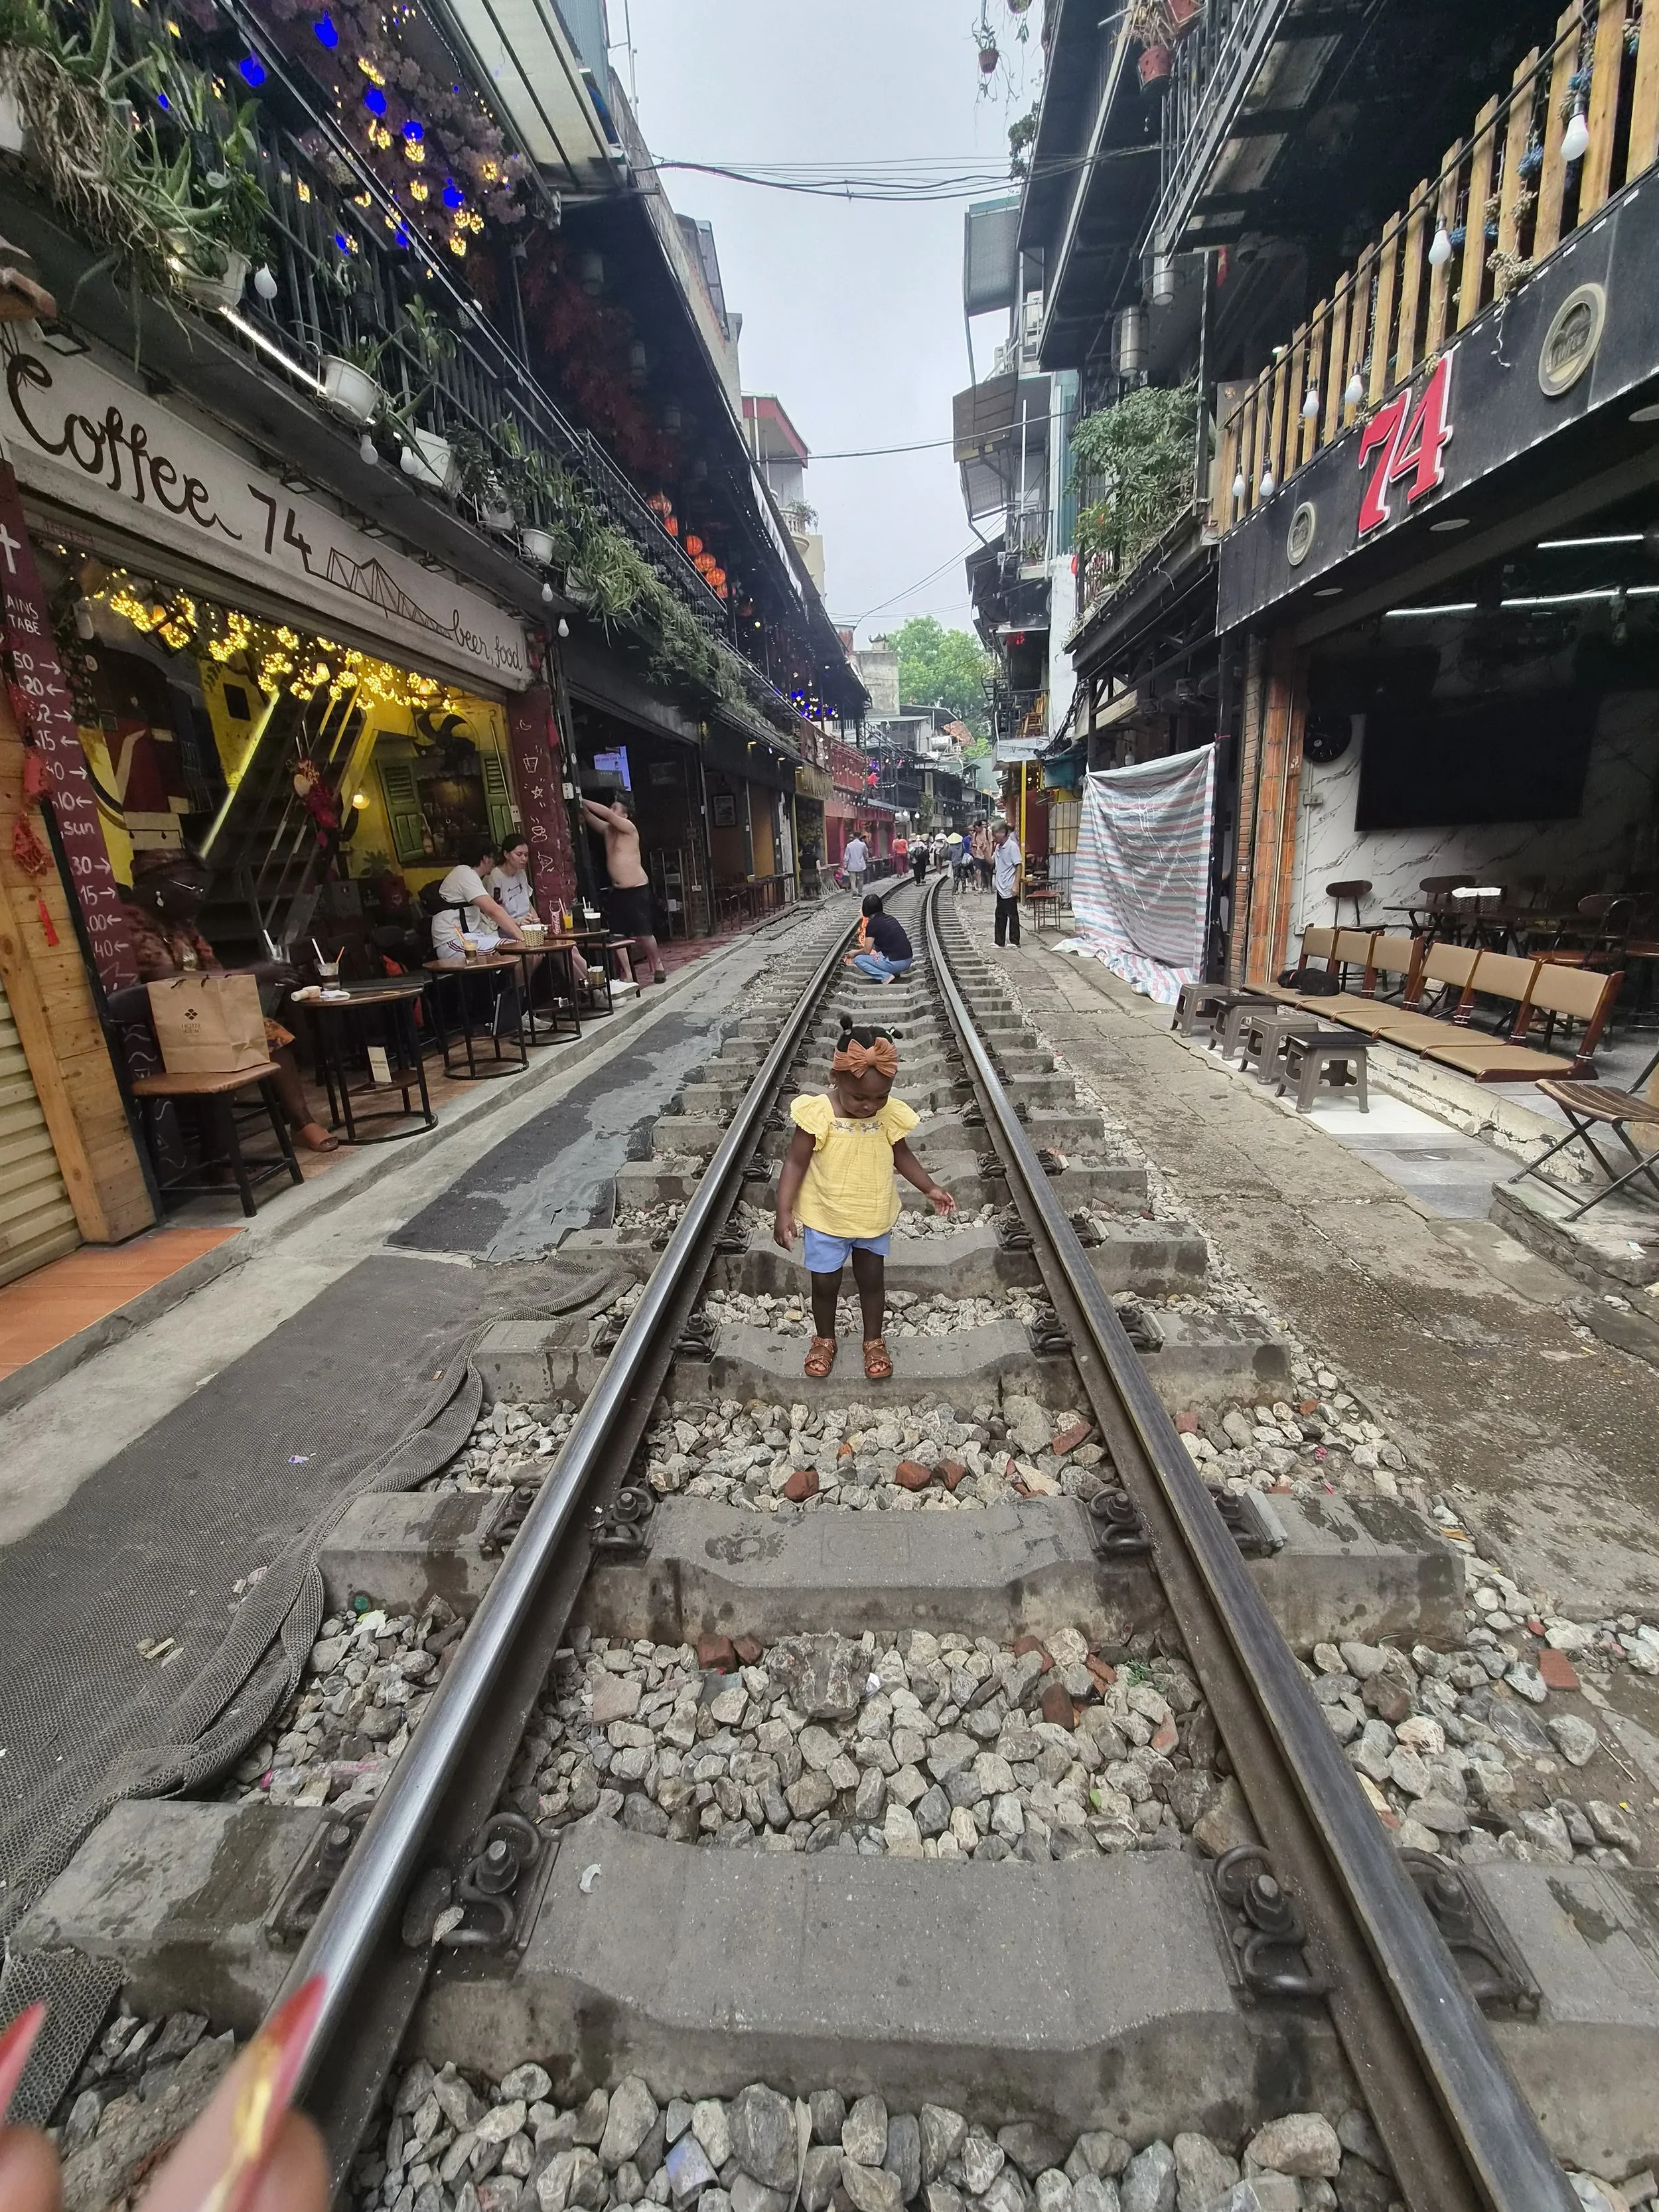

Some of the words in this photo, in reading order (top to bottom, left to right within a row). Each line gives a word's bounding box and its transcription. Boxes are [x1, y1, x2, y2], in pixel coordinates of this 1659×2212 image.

[7, 354, 243, 541] Coffee
[248, 483, 313, 569] 74
[1358, 349, 1453, 538] 74
[5, 594, 39, 620] AINS
[13, 650, 35, 672] 50
[494, 635, 523, 672] food
